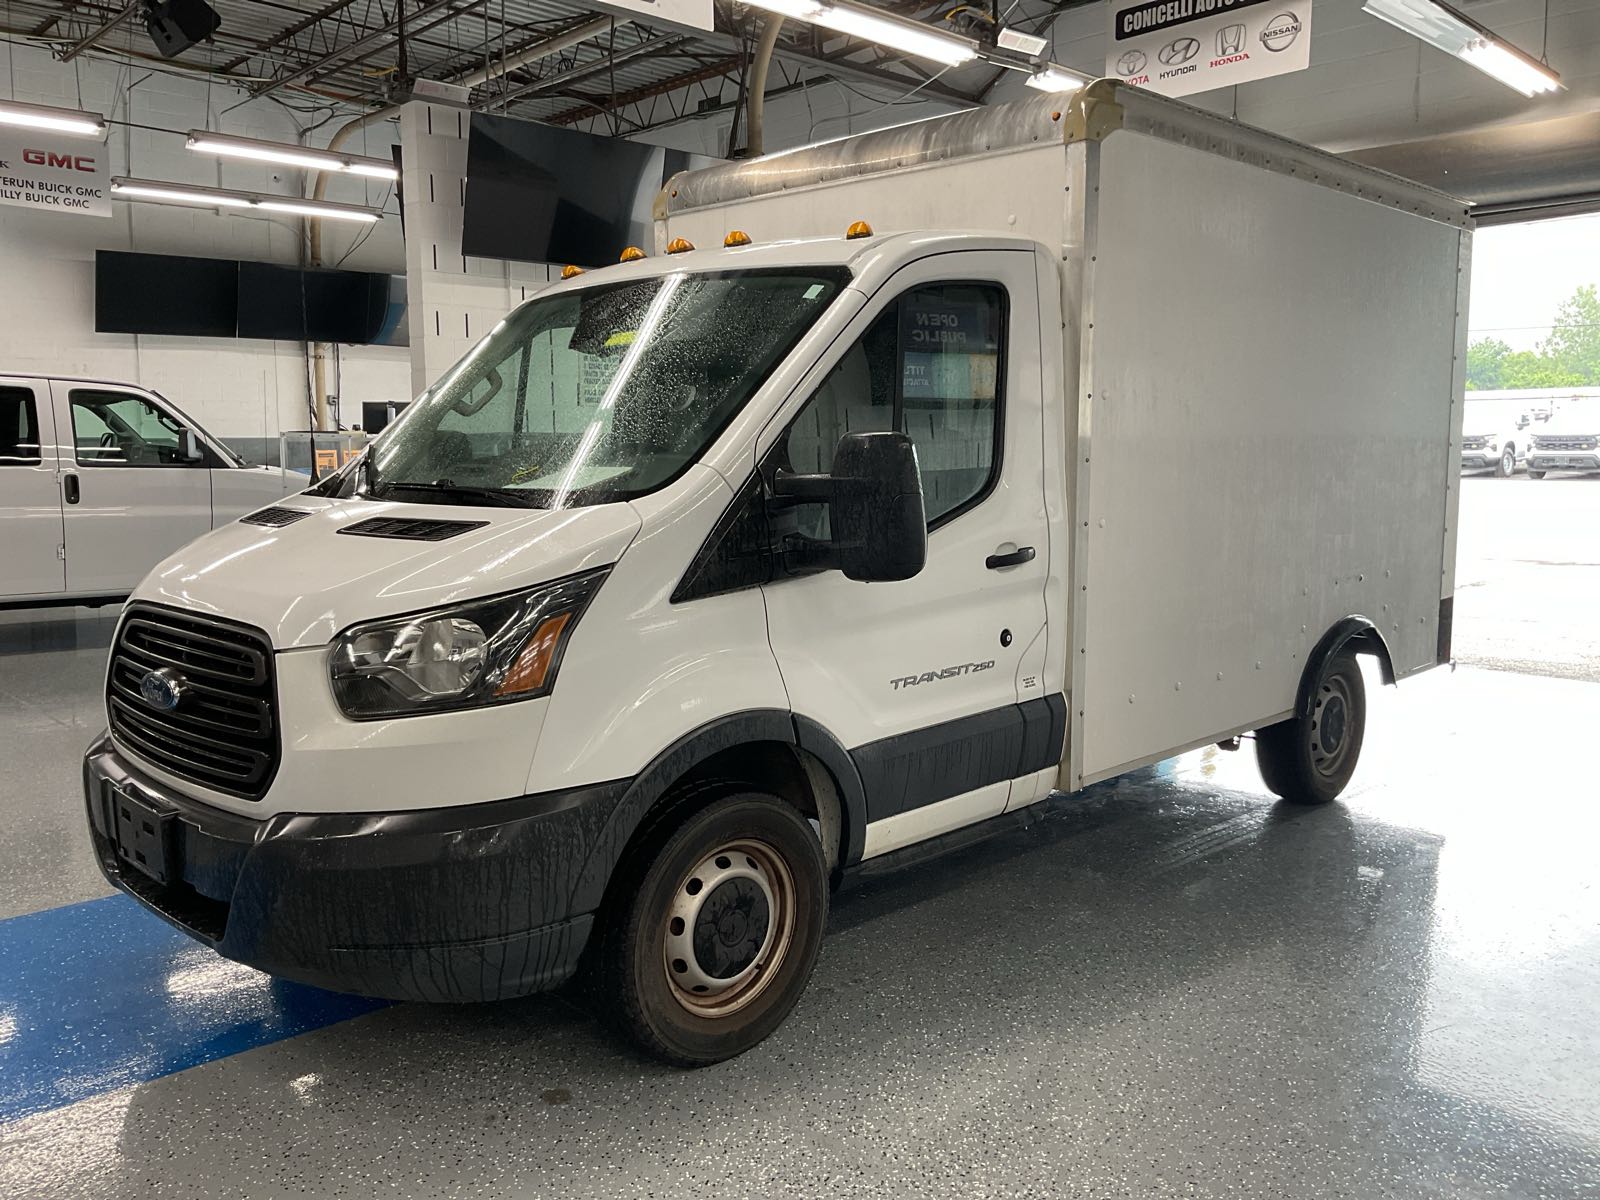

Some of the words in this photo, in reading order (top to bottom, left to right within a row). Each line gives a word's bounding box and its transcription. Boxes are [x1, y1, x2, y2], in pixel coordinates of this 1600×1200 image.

[1123, 0, 1193, 33] CONICELLI
[1263, 24, 1298, 38] NISSAN
[1209, 53, 1250, 68] HONDA
[1159, 64, 1197, 80] HYUNDAI
[23, 148, 96, 172] GMC
[38, 181, 72, 195] BUICK
[75, 186, 102, 198] GMC
[25, 192, 60, 205] BUICK
[63, 197, 90, 209] GMC
[890, 662, 974, 690] TRANSIT
